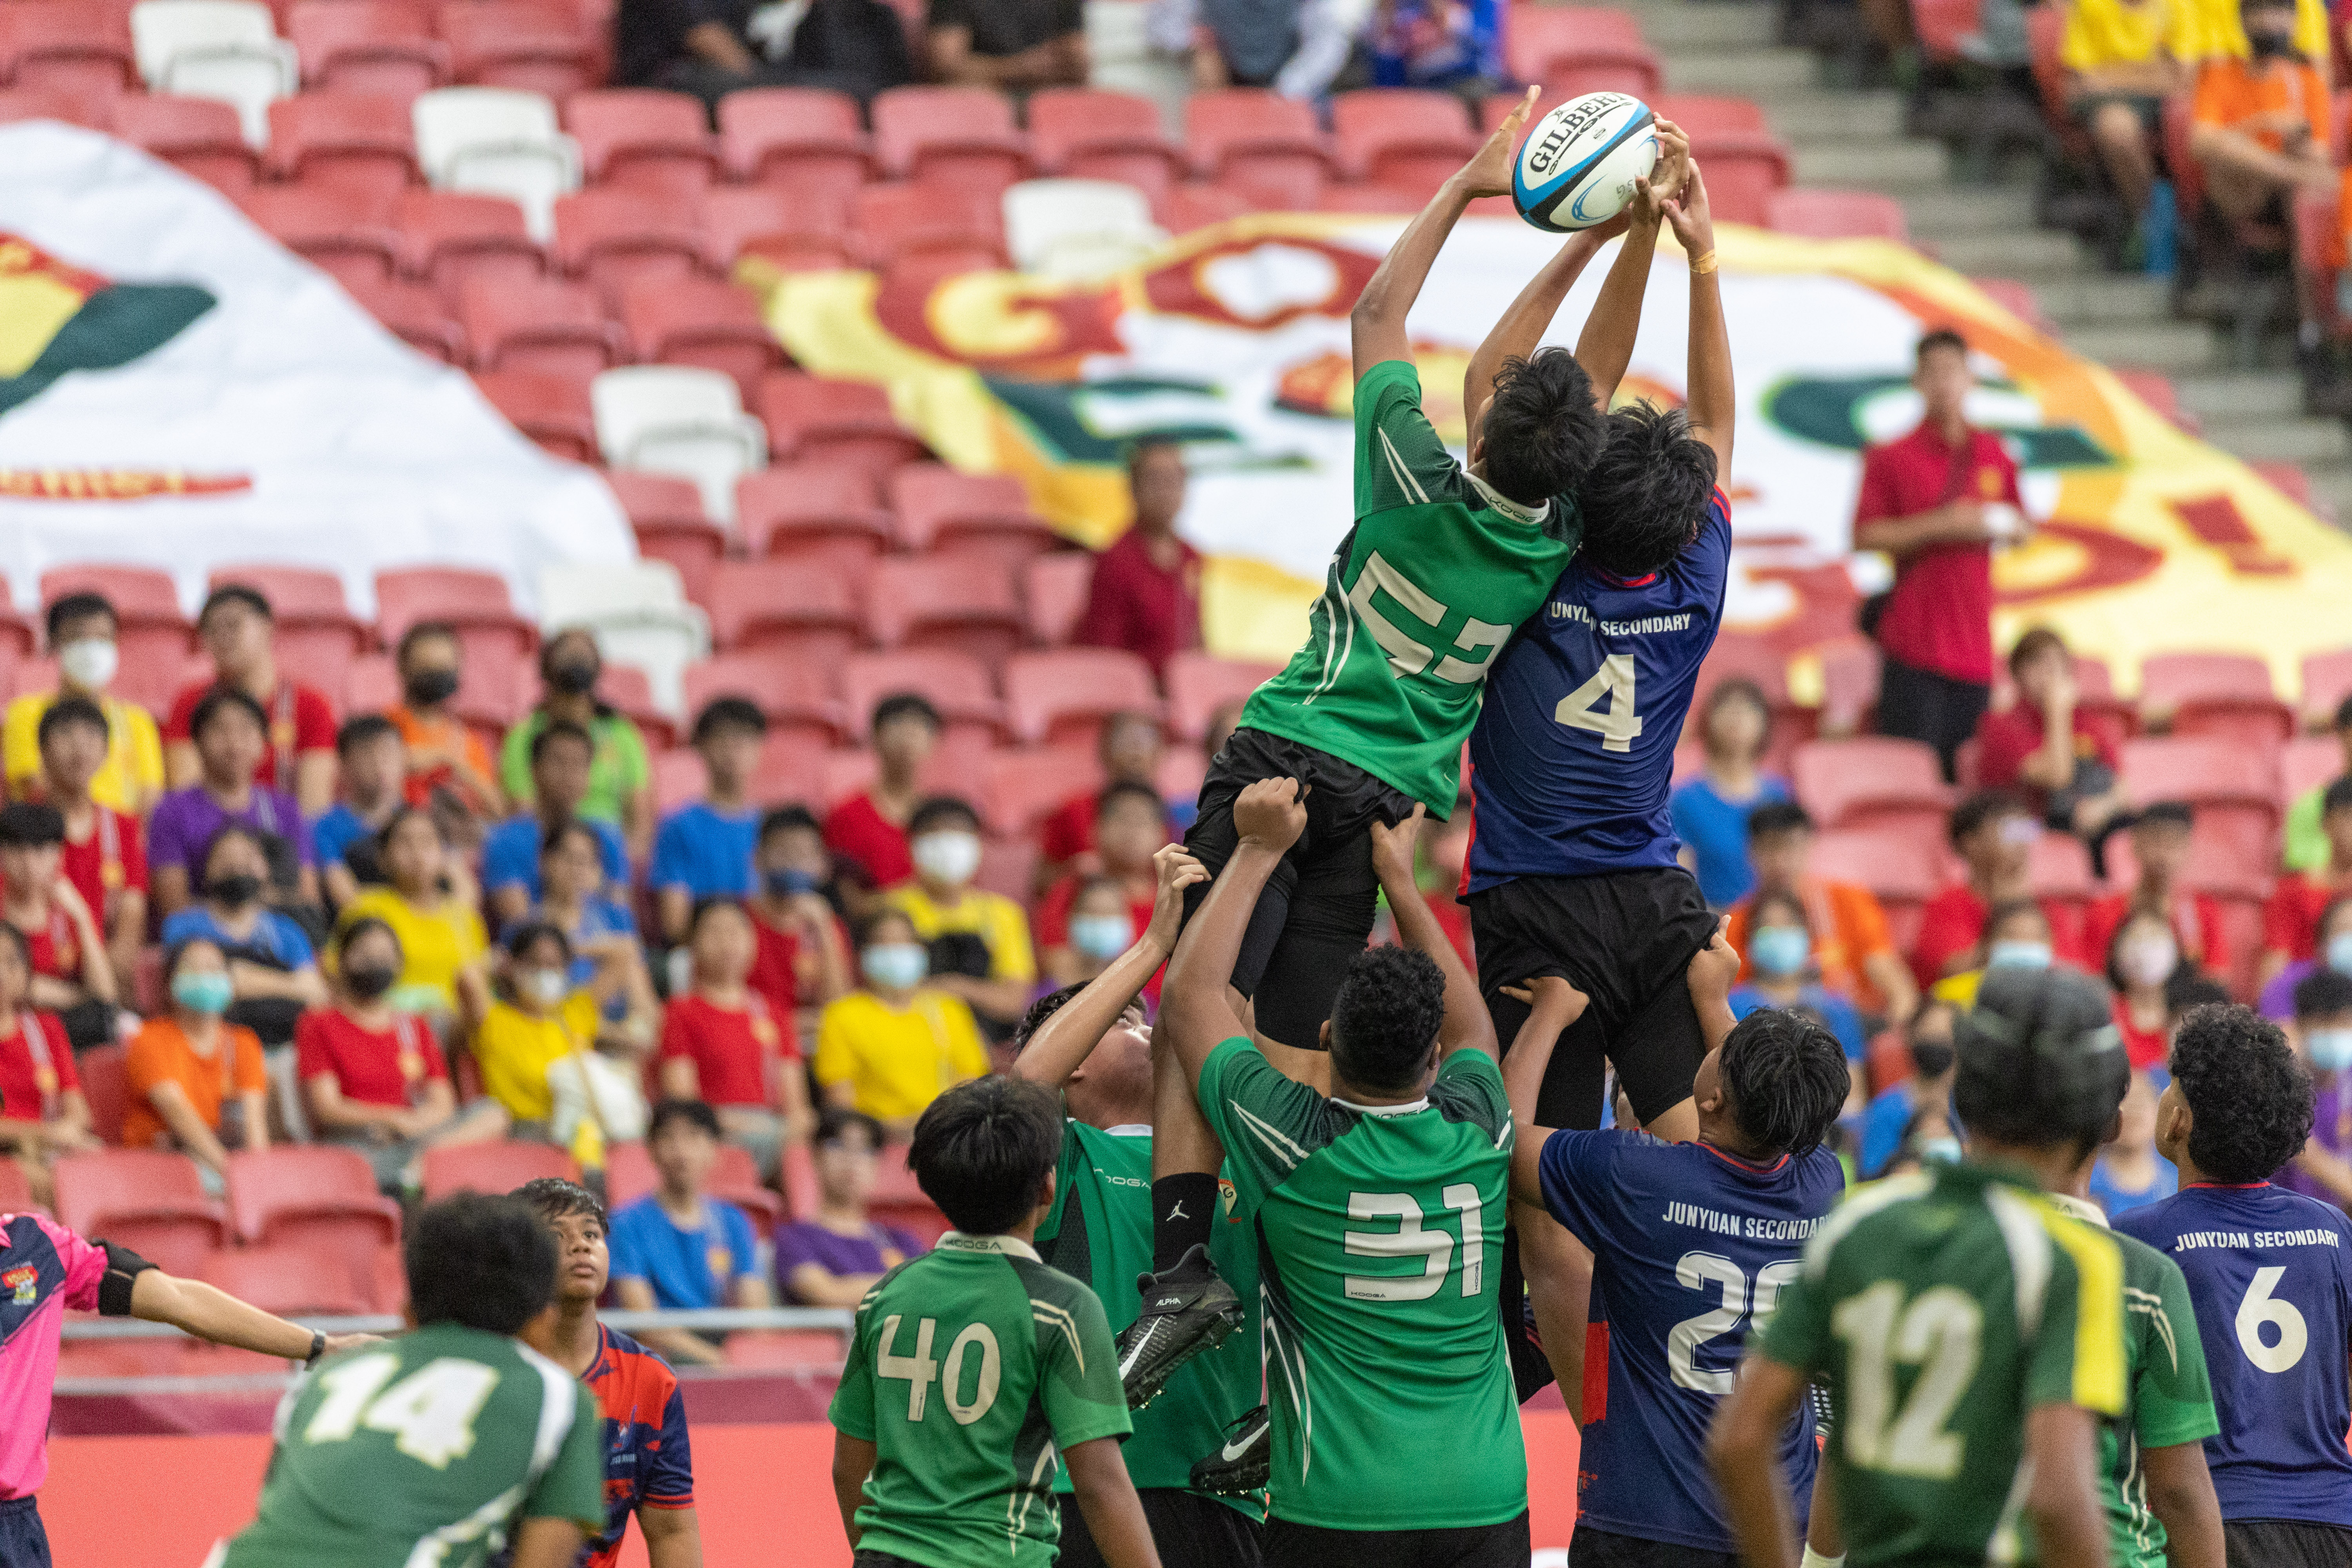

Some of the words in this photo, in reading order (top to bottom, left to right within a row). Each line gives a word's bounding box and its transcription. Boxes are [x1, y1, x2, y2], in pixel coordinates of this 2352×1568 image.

[1530, 93, 1627, 172] GILBERT
[1489, 497, 1542, 522] KOOG
[1600, 613, 1691, 636] SECONDARY
[1555, 653, 1642, 752] 4
[945, 1239, 1002, 1250] KOOGA
[1343, 1182, 1483, 1302] 31
[1662, 1201, 1740, 1236] JUNYUAN
[1745, 1214, 1829, 1240] SECONDAR
[2175, 1232, 2250, 1252] JUNYUAN
[2254, 1229, 2339, 1248] SECONDARY
[1155, 1297, 1181, 1307] ALPHA
[2235, 1266, 2307, 1373] 6
[877, 1314, 1001, 1425] 40
[1831, 1280, 1982, 1479] 12
[305, 1354, 499, 1470] 14
